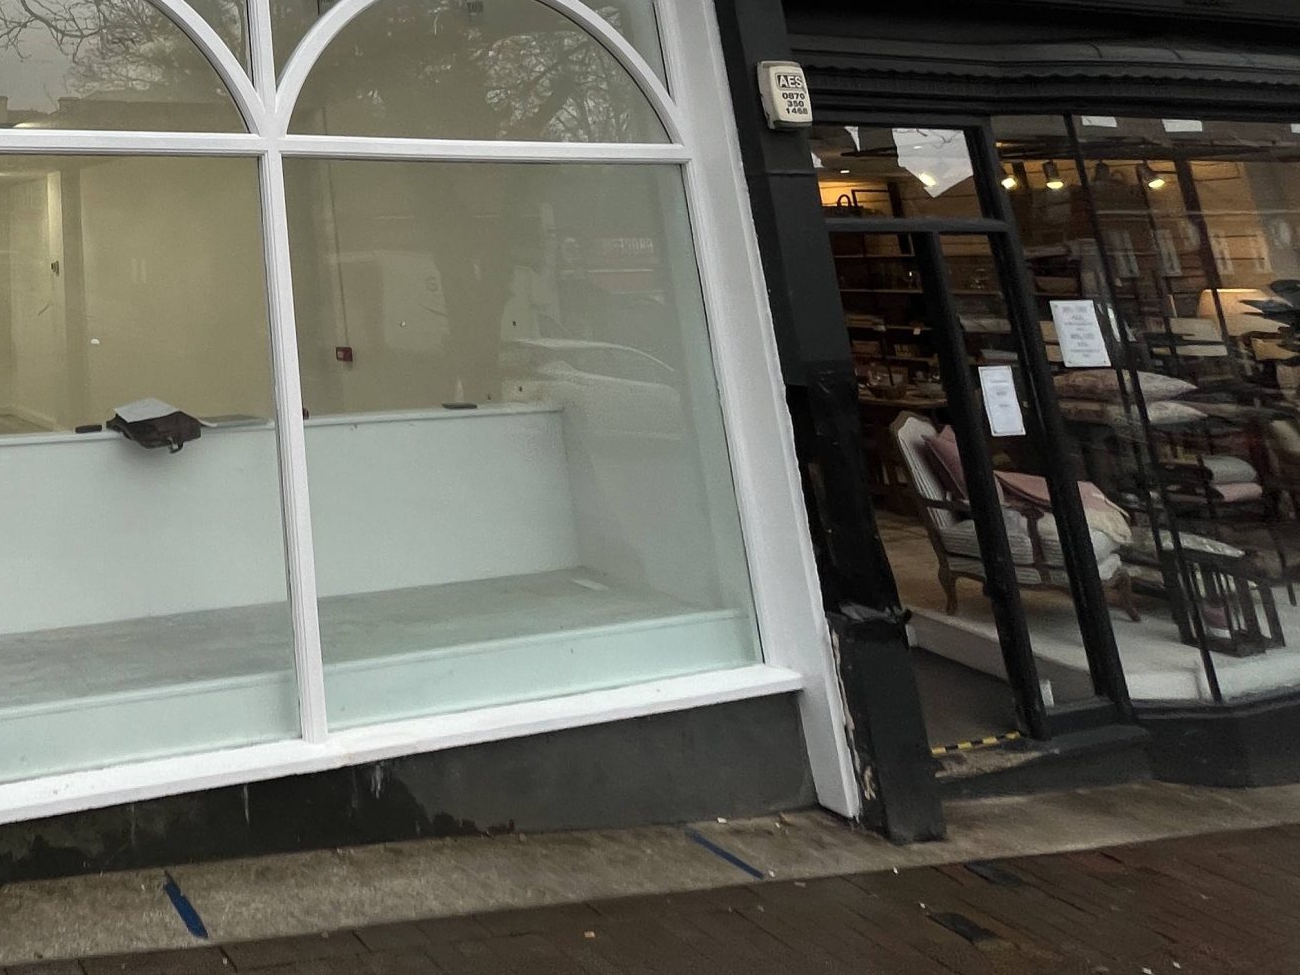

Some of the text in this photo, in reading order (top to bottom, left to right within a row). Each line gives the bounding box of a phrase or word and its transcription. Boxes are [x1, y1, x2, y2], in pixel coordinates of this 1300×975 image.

[779, 74, 803, 88] AES
[782, 92, 805, 100] 0870
[788, 100, 804, 108] 350
